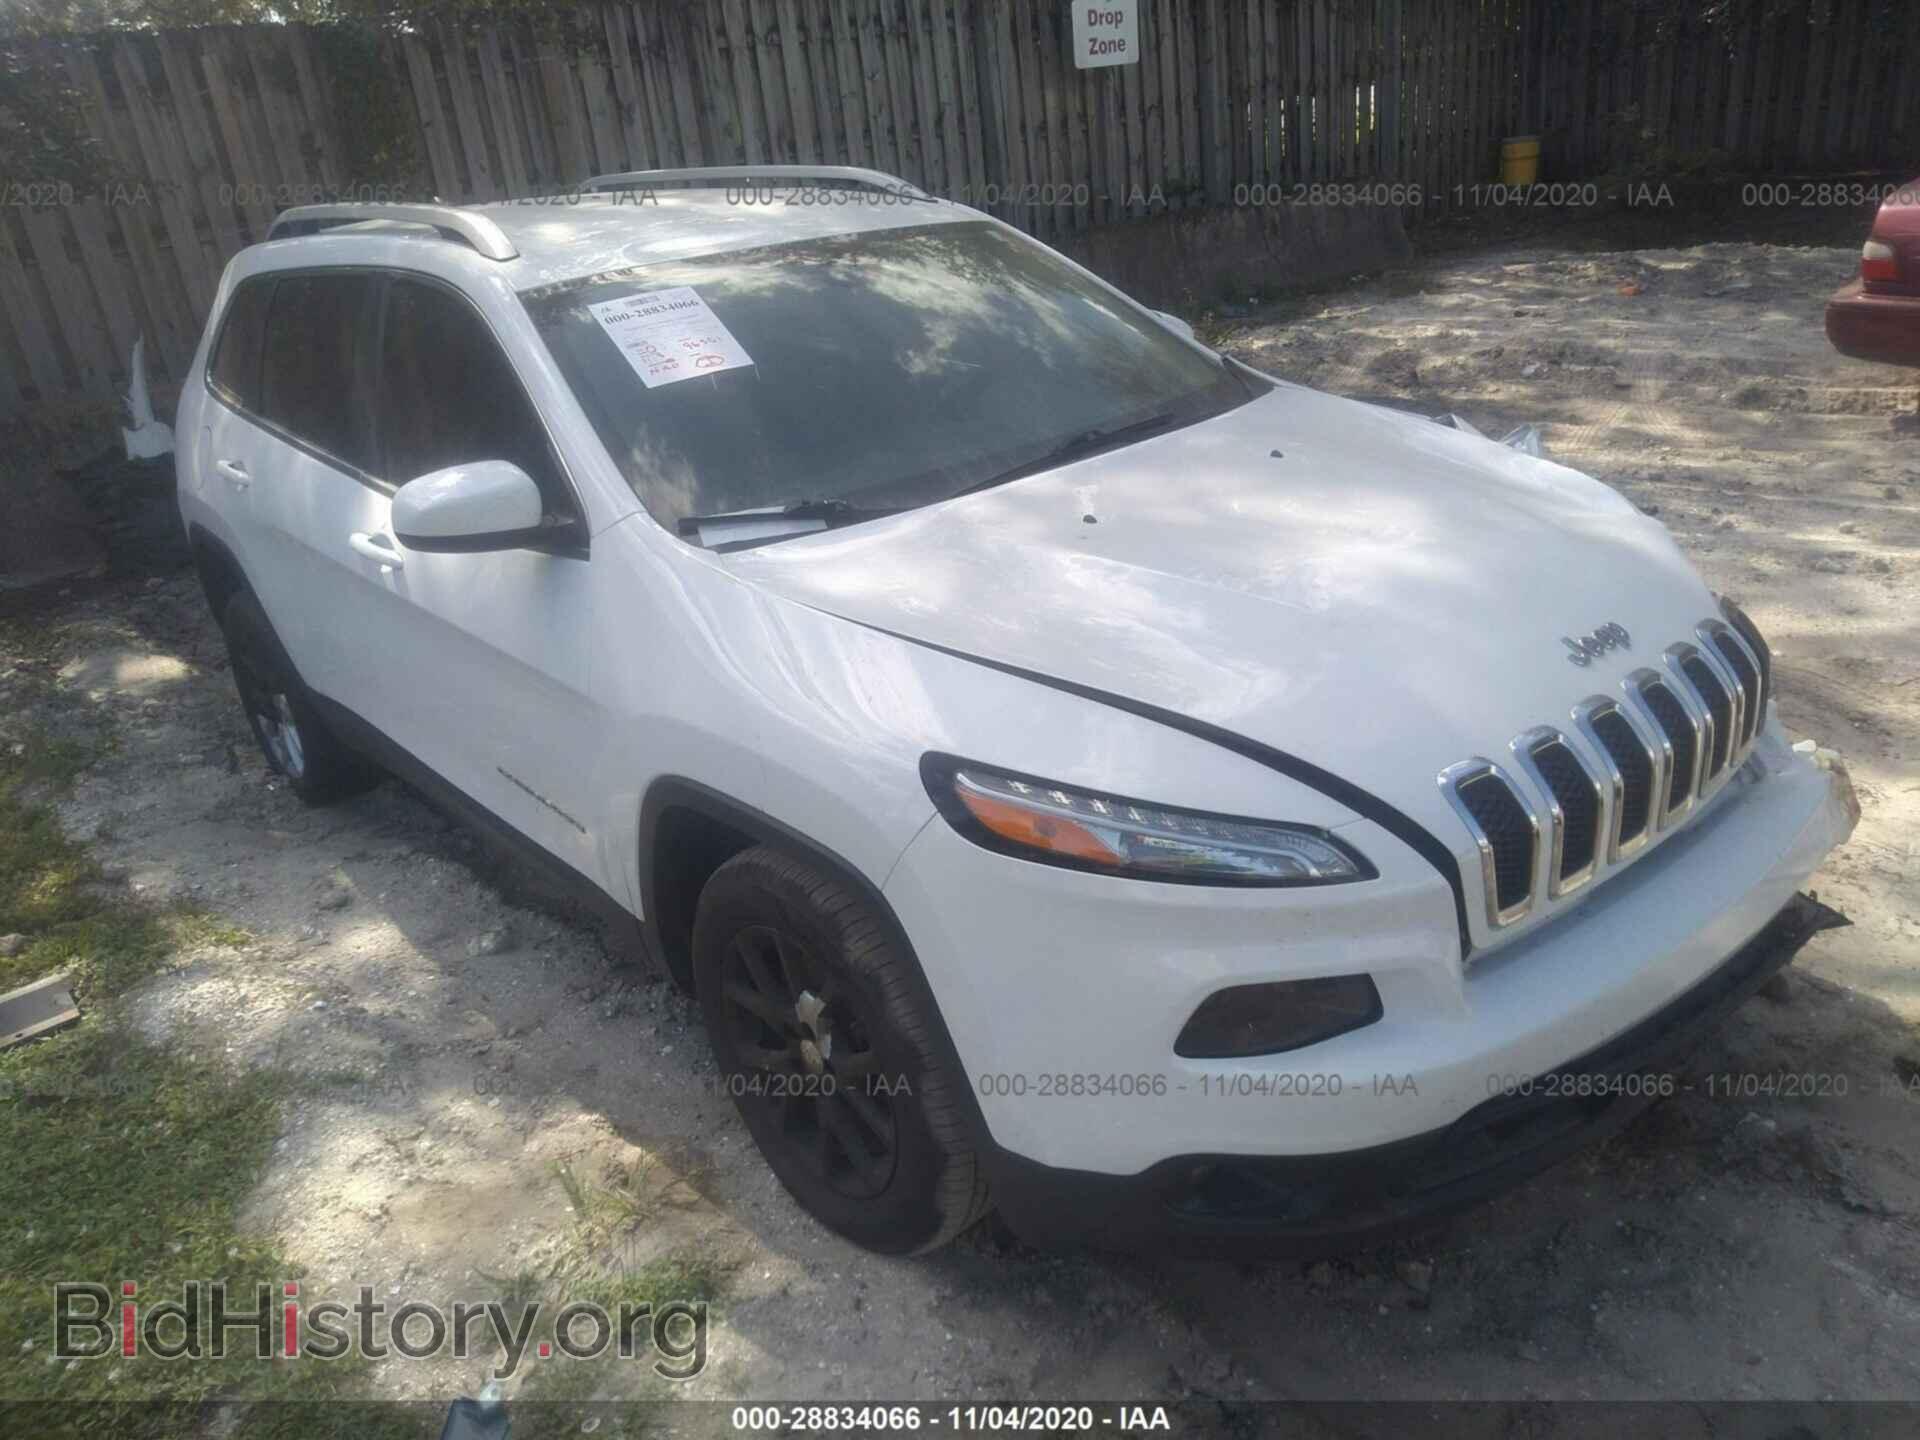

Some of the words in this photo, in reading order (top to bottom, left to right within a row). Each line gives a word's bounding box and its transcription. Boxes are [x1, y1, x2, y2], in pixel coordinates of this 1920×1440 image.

[1087, 9, 1124, 29] Drop
[1088, 37, 1127, 56] Zone
[1560, 621, 1631, 668] Jeep
